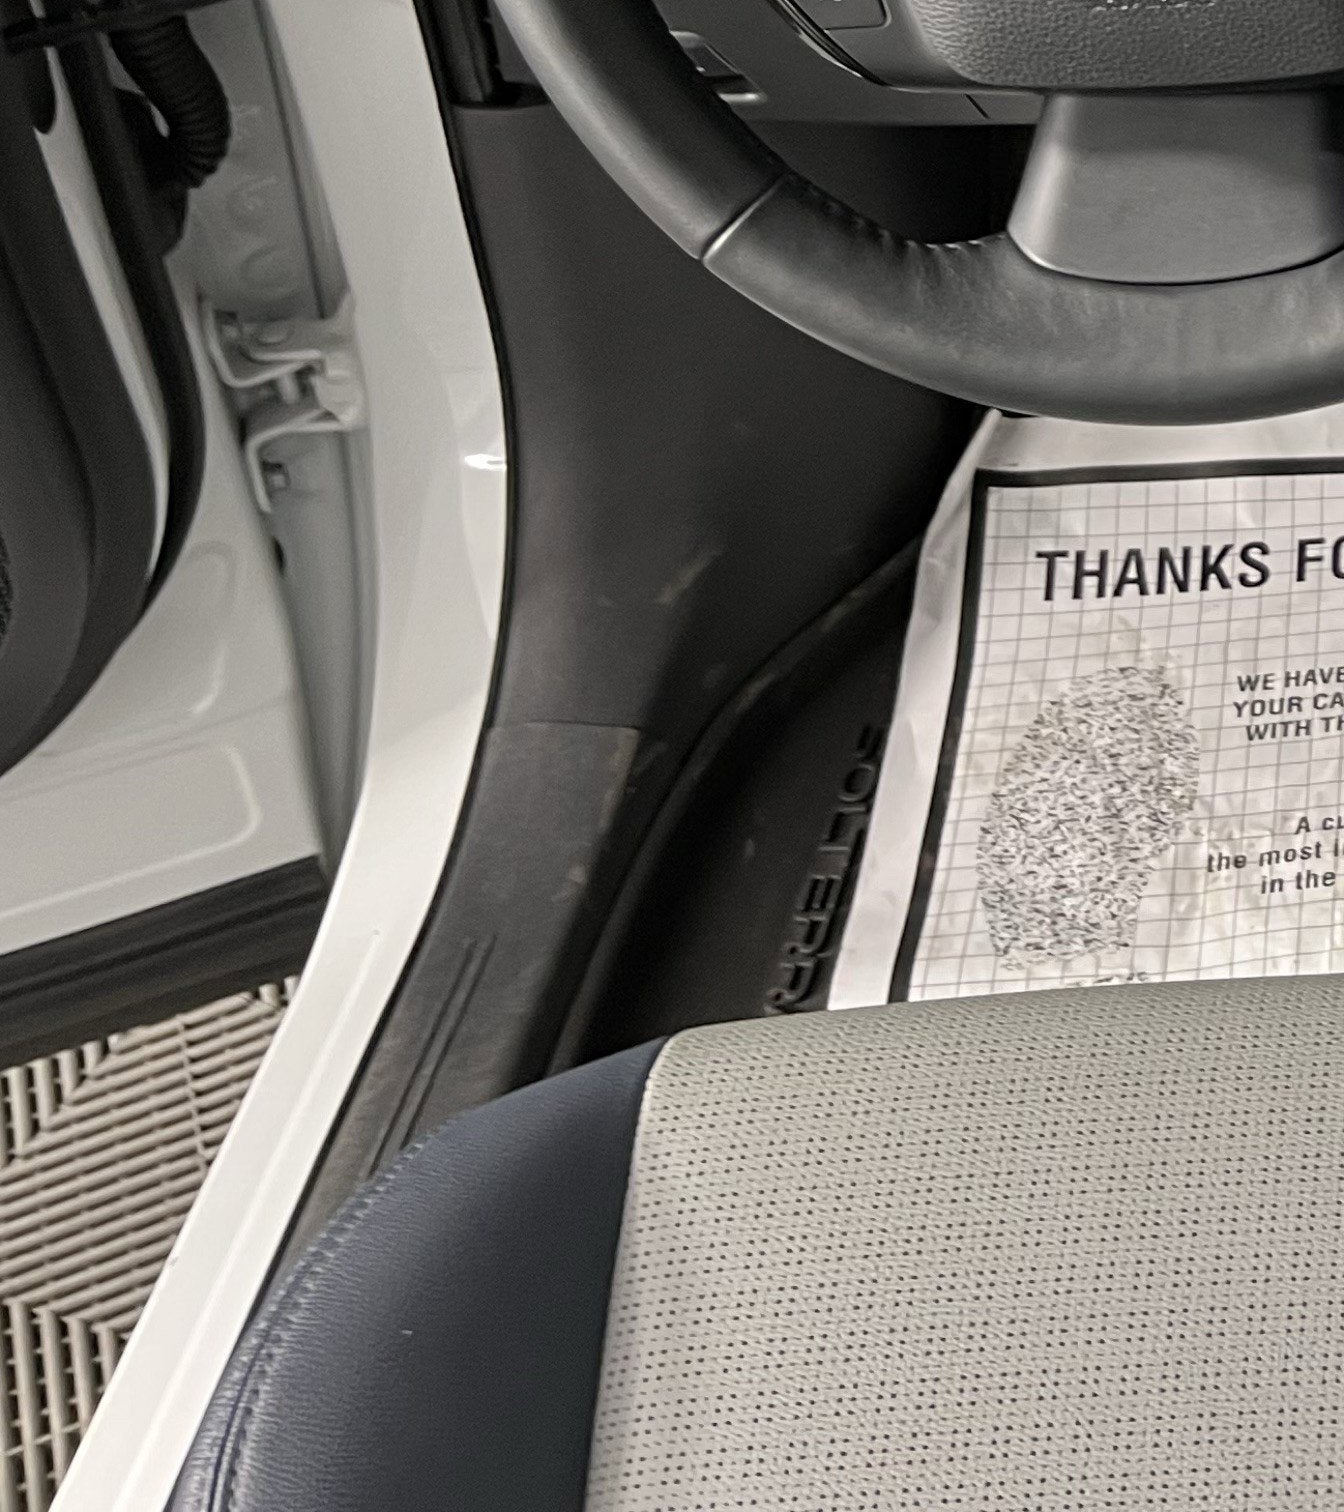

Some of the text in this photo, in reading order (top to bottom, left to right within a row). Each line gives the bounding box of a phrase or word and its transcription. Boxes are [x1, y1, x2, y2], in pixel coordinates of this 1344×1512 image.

[1035, 539, 1271, 602] THANKS
[1236, 671, 1276, 693] WE
[1233, 696, 1303, 719] YOUR
[1245, 720, 1312, 742] WITH
[1294, 815, 1312, 836] A
[1206, 852, 1248, 873] the
[1257, 840, 1323, 868] most
[1260, 875, 1285, 895] in
[1294, 867, 1337, 891] the
